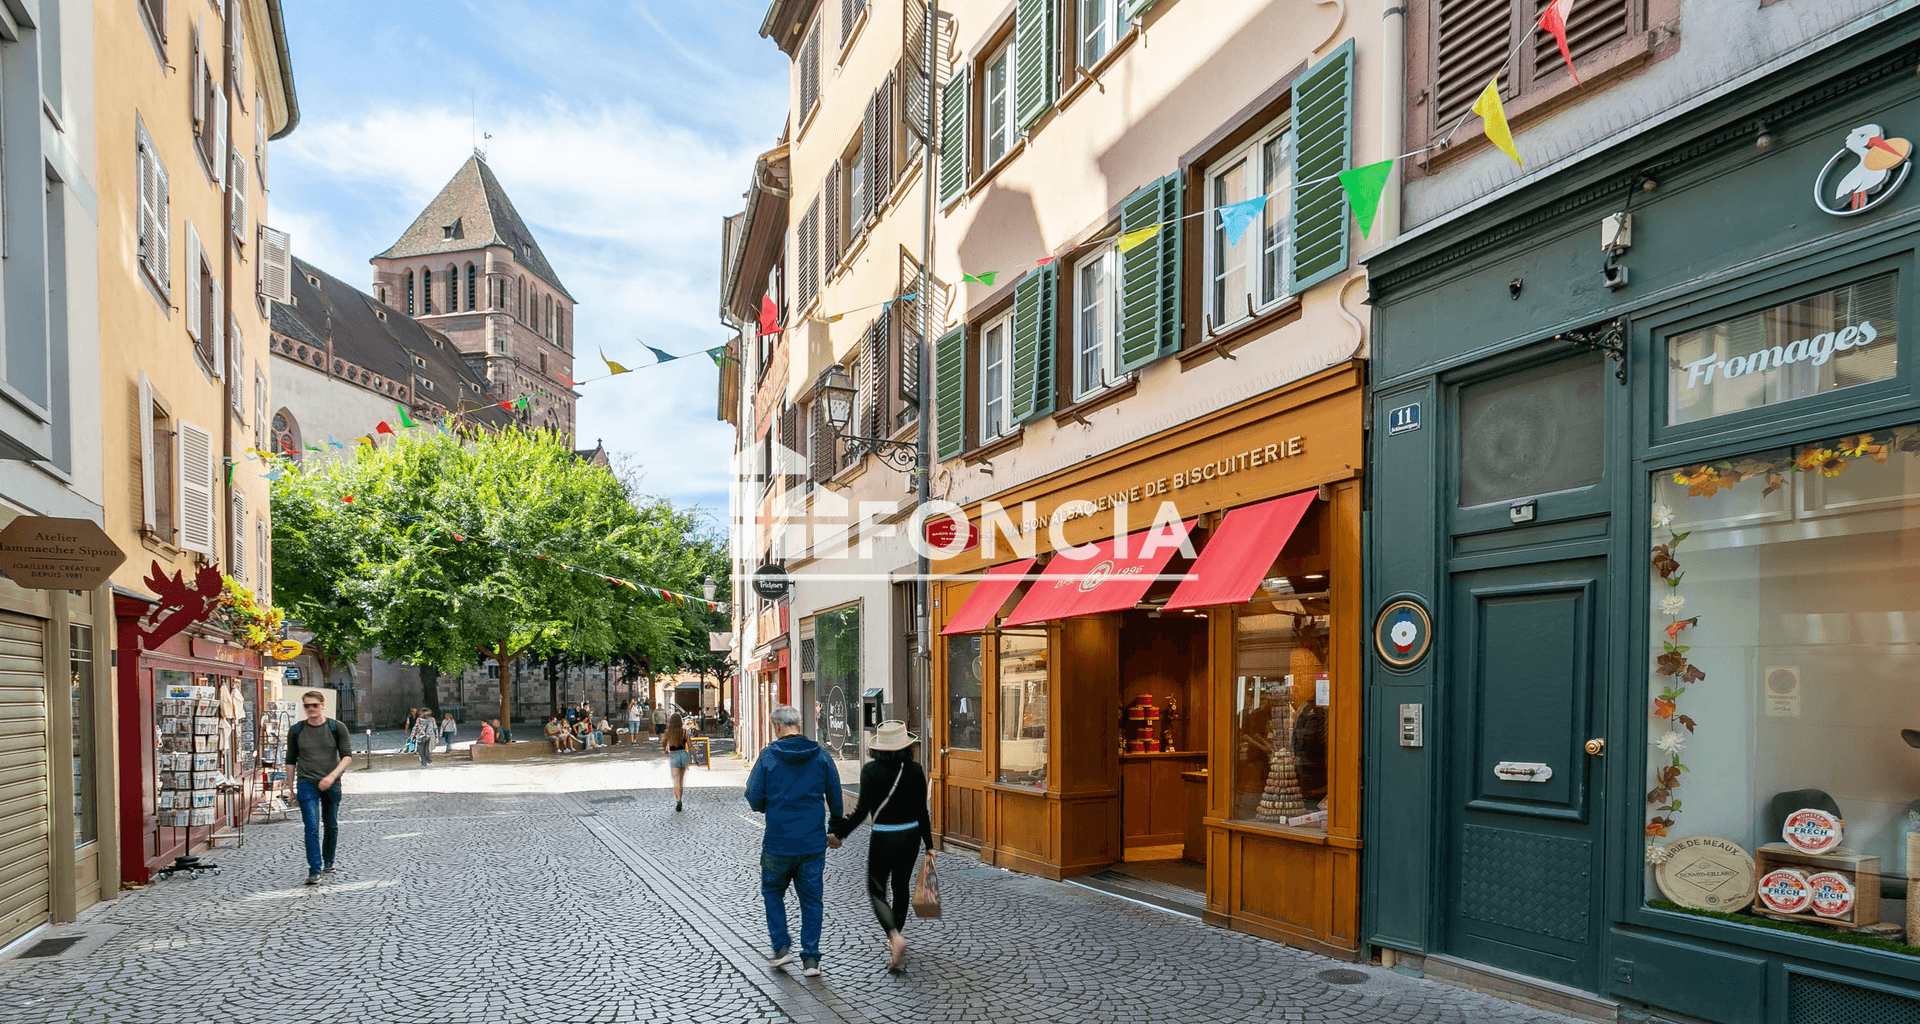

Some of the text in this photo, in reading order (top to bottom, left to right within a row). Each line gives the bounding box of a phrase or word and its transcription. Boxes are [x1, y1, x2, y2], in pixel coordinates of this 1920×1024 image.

[1683, 321, 1877, 389] Fromages
[1397, 406, 1412, 425] 11
[1004, 435, 1303, 538] MAISON ALSACIENNE DE BISCUITERIE
[35, 532, 78, 543] Atelier
[79, 546, 117, 558] Sipion
[59, 564, 100, 572] CRÉATEUR
[1115, 565, 1145, 576] 1996
[1793, 827, 1828, 836] FRECH
[1667, 839, 1740, 858] BRIE DE MEAUX
[1768, 887, 1800, 896] FRECH
